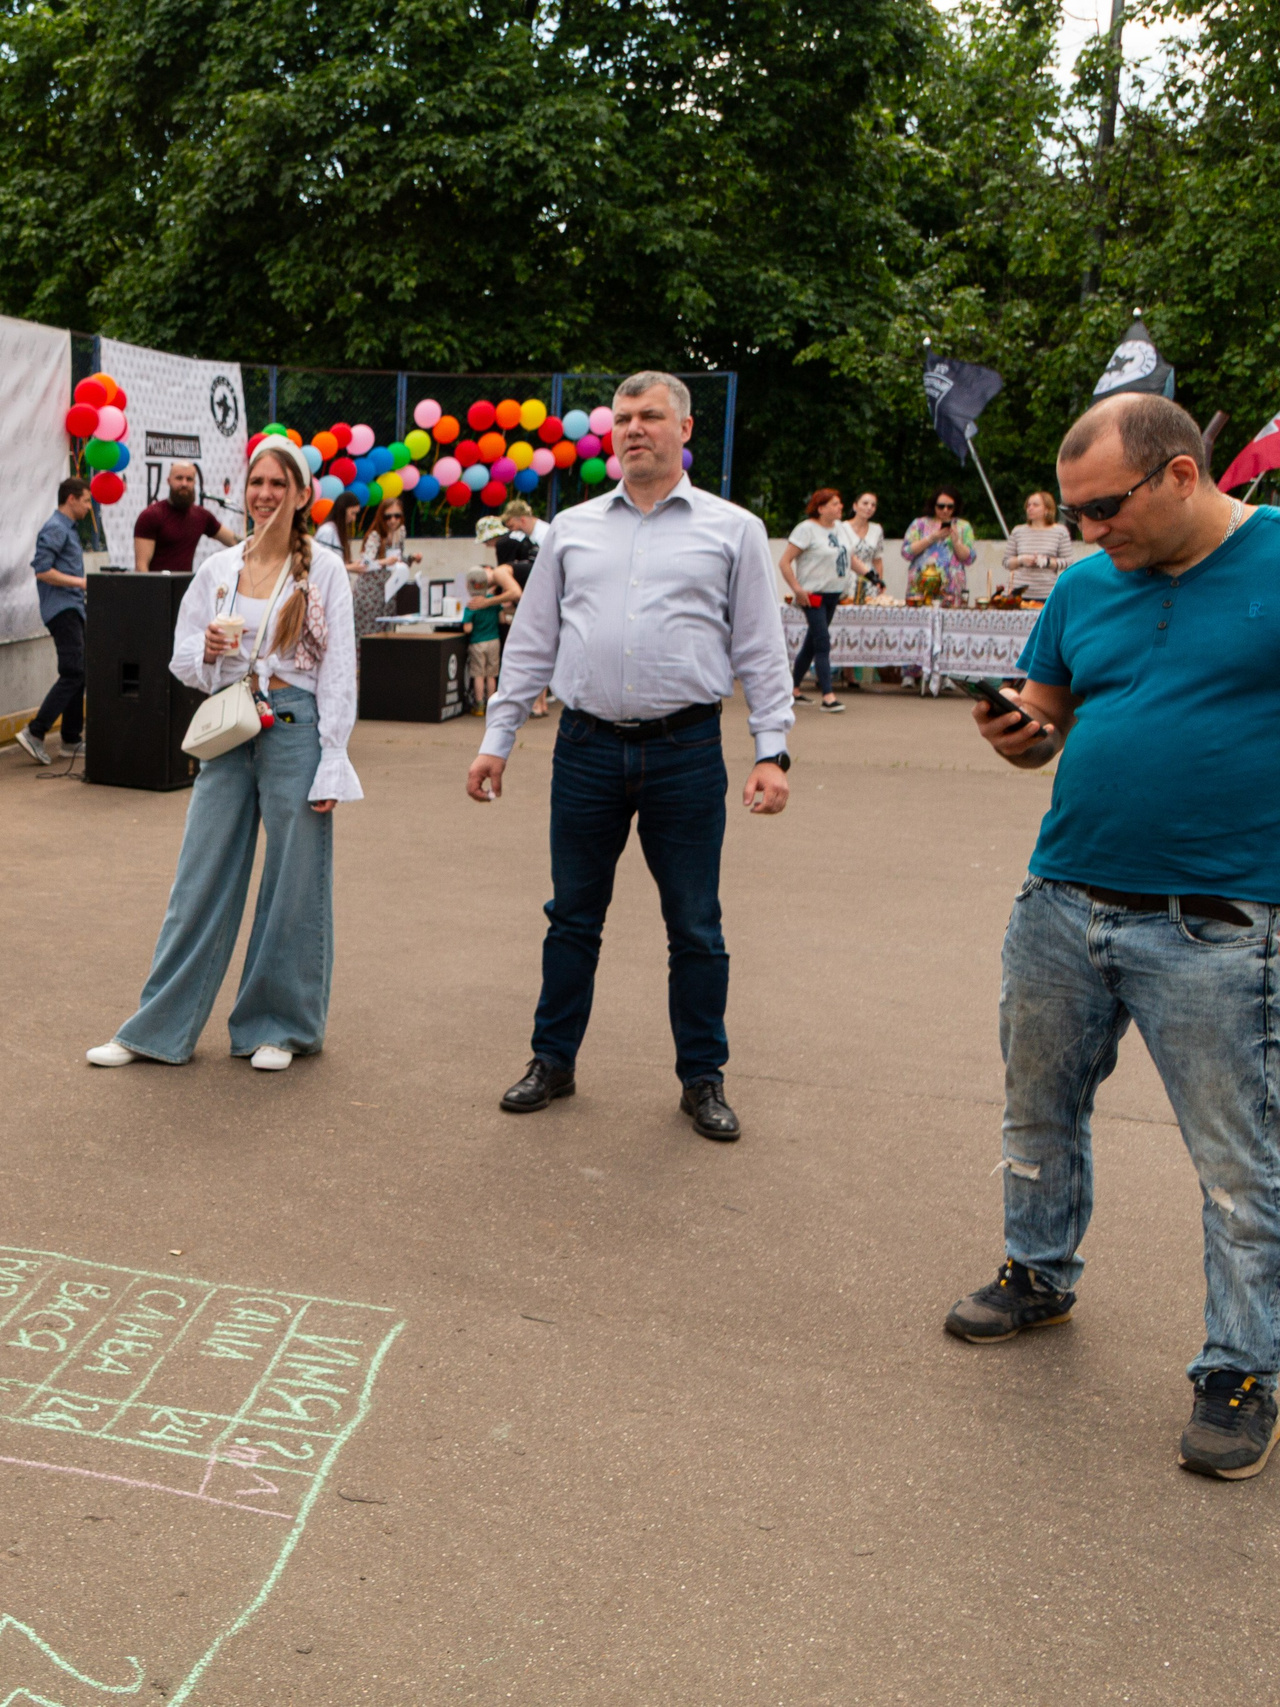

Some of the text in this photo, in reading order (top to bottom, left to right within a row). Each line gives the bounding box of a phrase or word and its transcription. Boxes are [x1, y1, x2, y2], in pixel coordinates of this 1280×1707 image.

[7, 1280, 109, 1351] ВАСЯ
[83, 1288, 185, 1374] СЛАВА
[198, 1297, 291, 1360] САША
[254, 1330, 361, 1421] ИМЯ
[138, 1407, 207, 1443] 24
